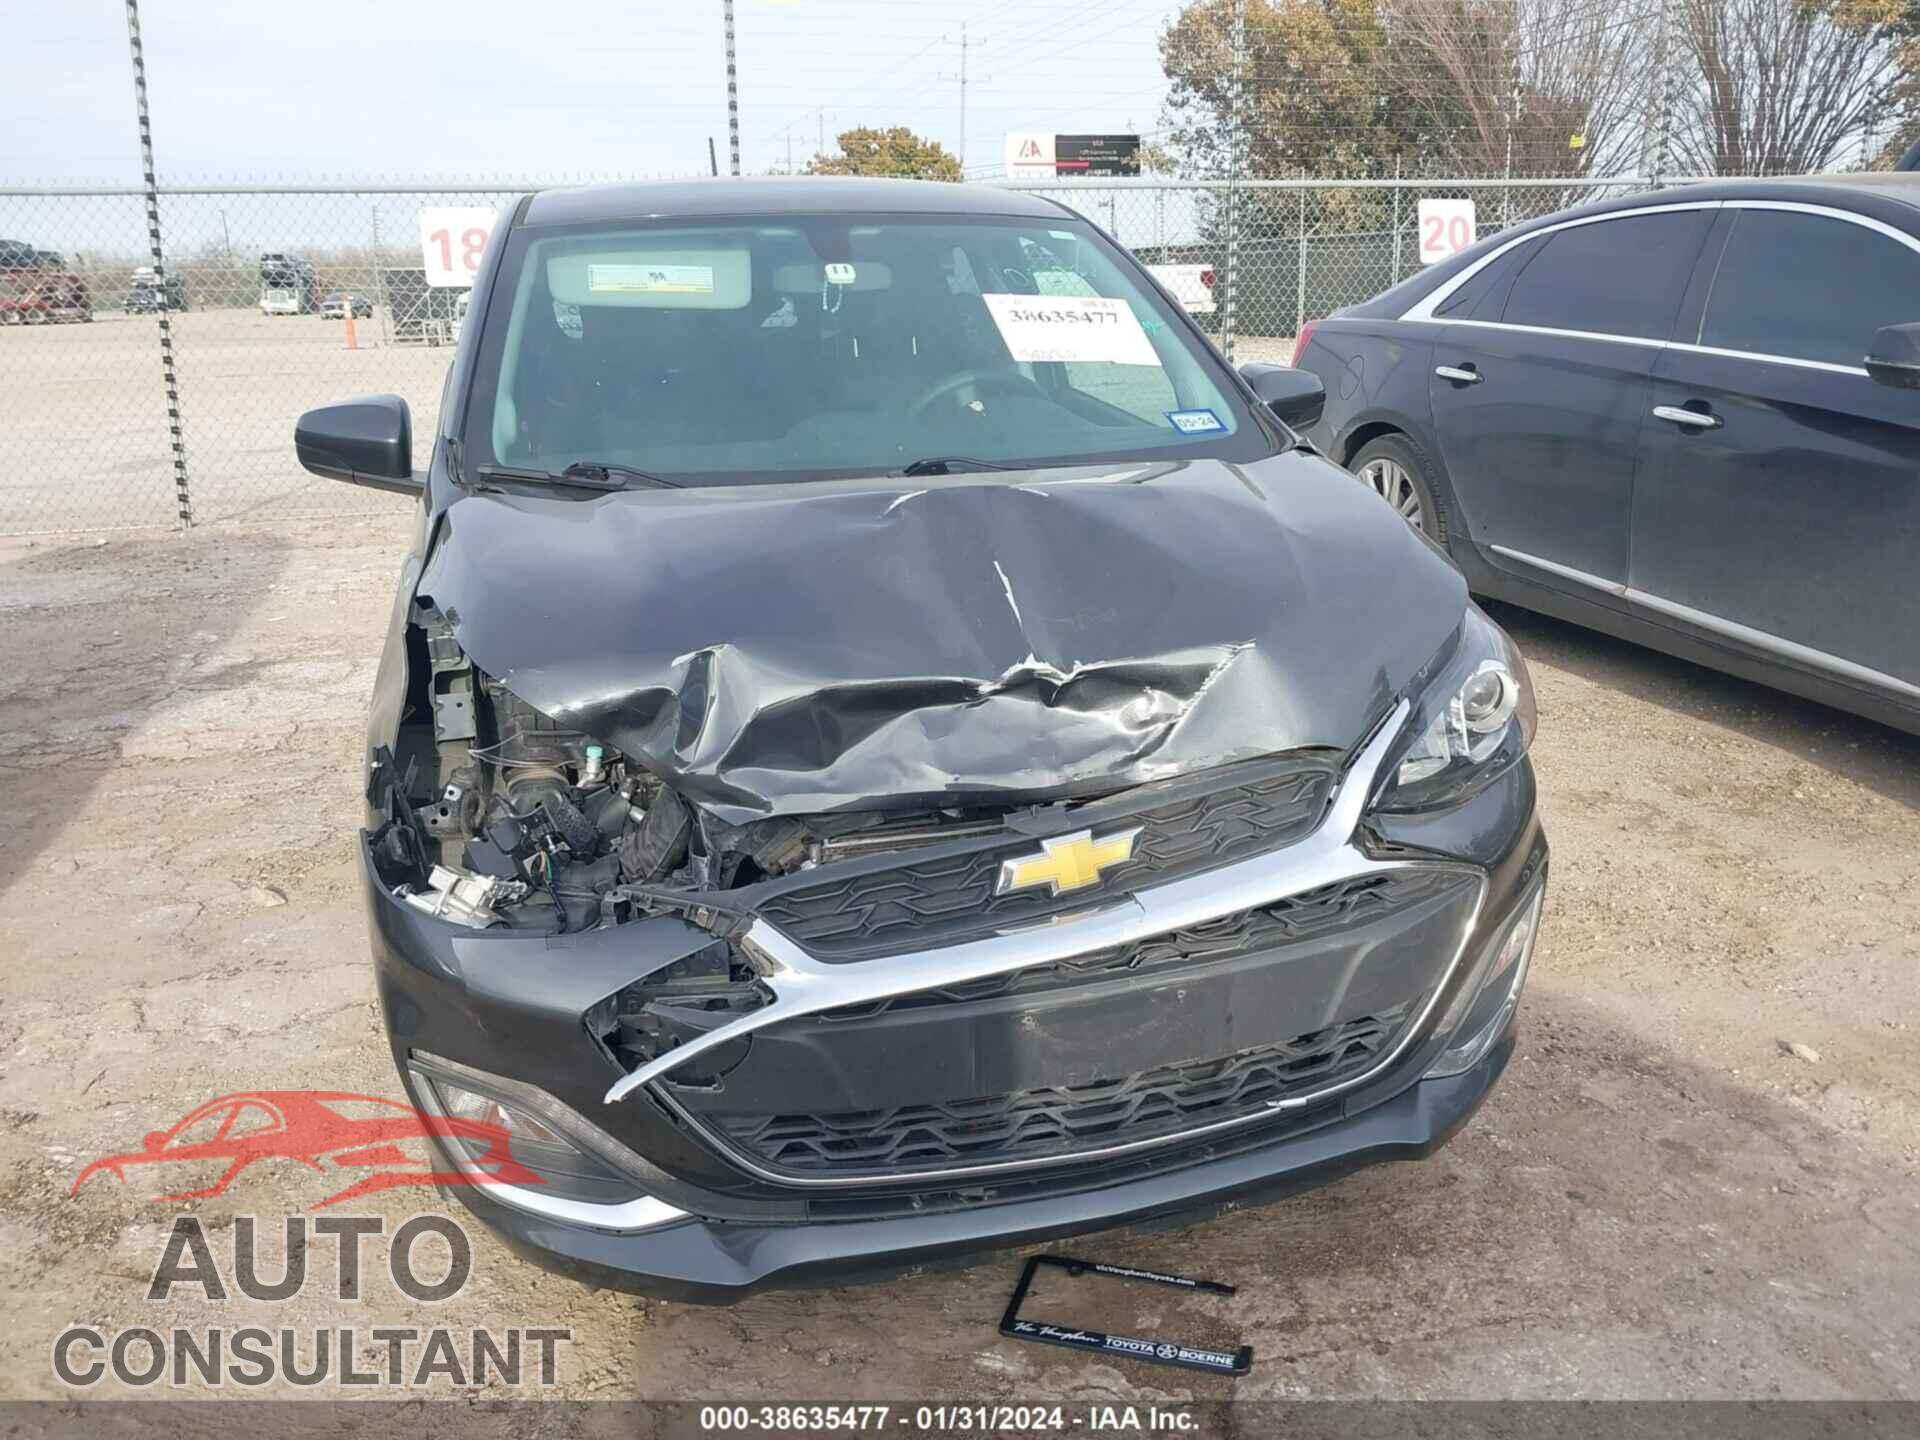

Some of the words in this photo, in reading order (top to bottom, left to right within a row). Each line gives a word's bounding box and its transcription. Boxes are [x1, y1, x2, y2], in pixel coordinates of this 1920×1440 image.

[430, 227, 488, 271] 18
[1423, 215, 1470, 252] 20
[1009, 309, 1119, 324] 38635477
[1105, 1338, 1155, 1354] TOYOTA
[1179, 1350, 1234, 1366] BOERNE
